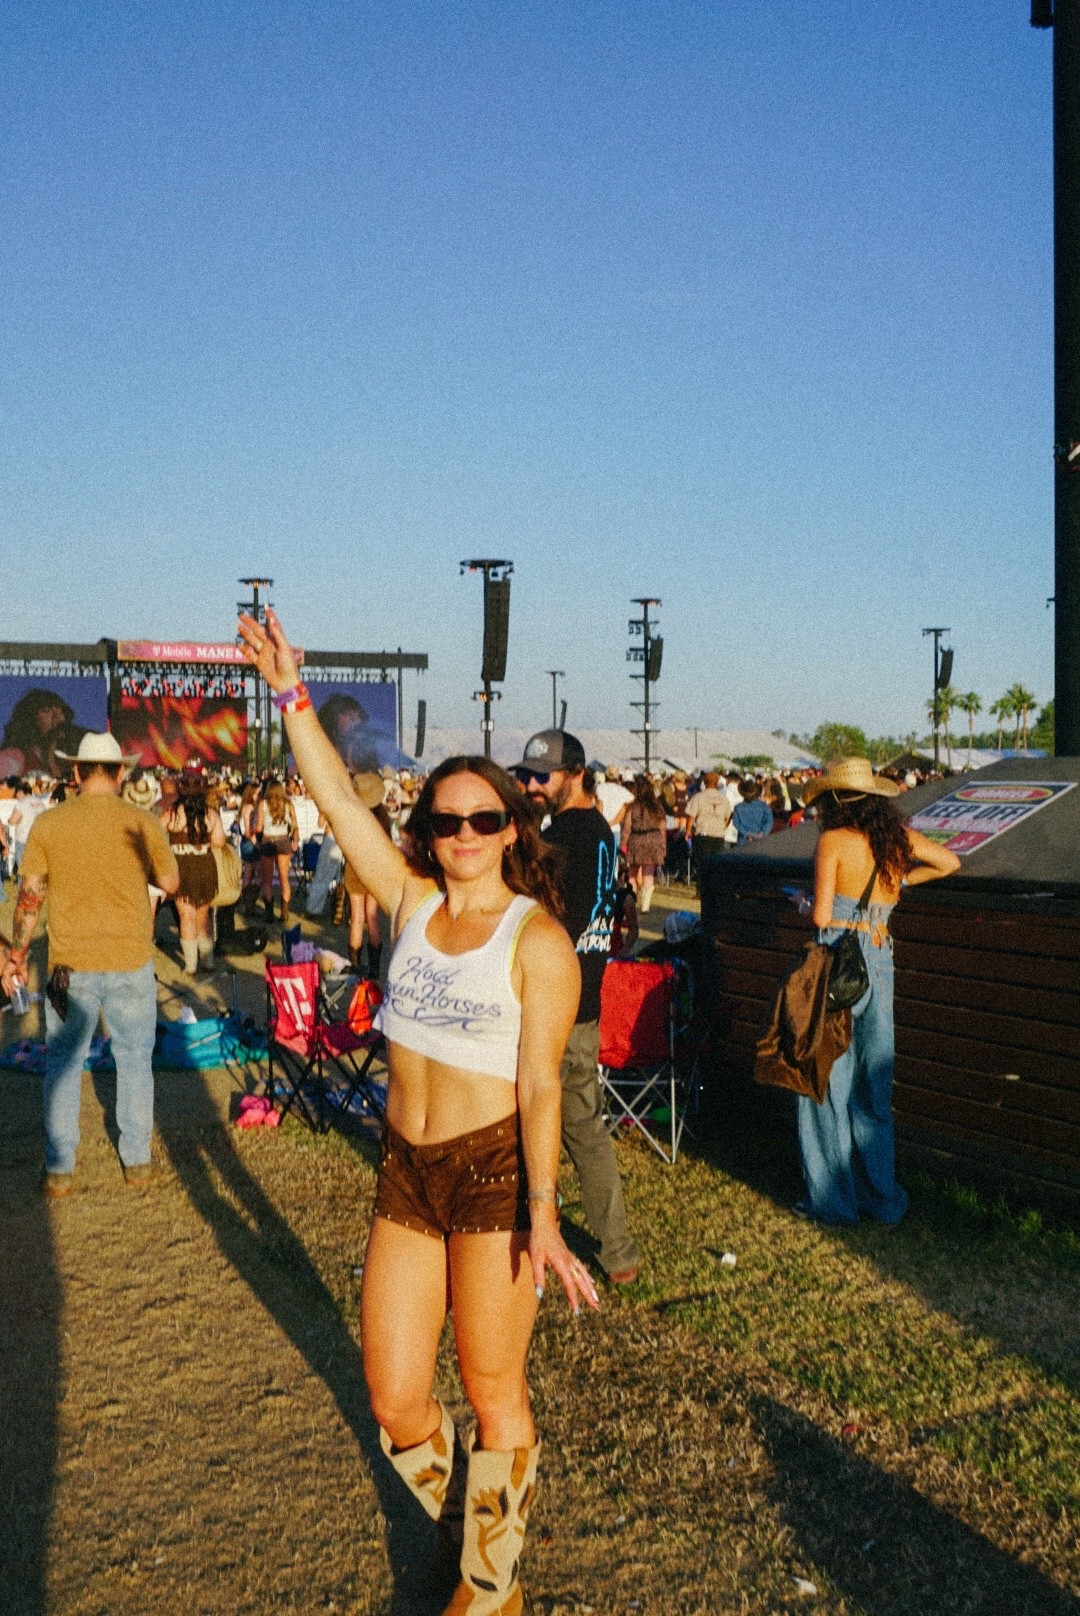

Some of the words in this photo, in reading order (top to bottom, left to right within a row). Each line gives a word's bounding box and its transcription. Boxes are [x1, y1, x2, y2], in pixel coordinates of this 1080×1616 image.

[162, 645, 192, 658] Mobile
[917, 803, 982, 818] KEEP
[420, 983, 501, 1017] Horses
